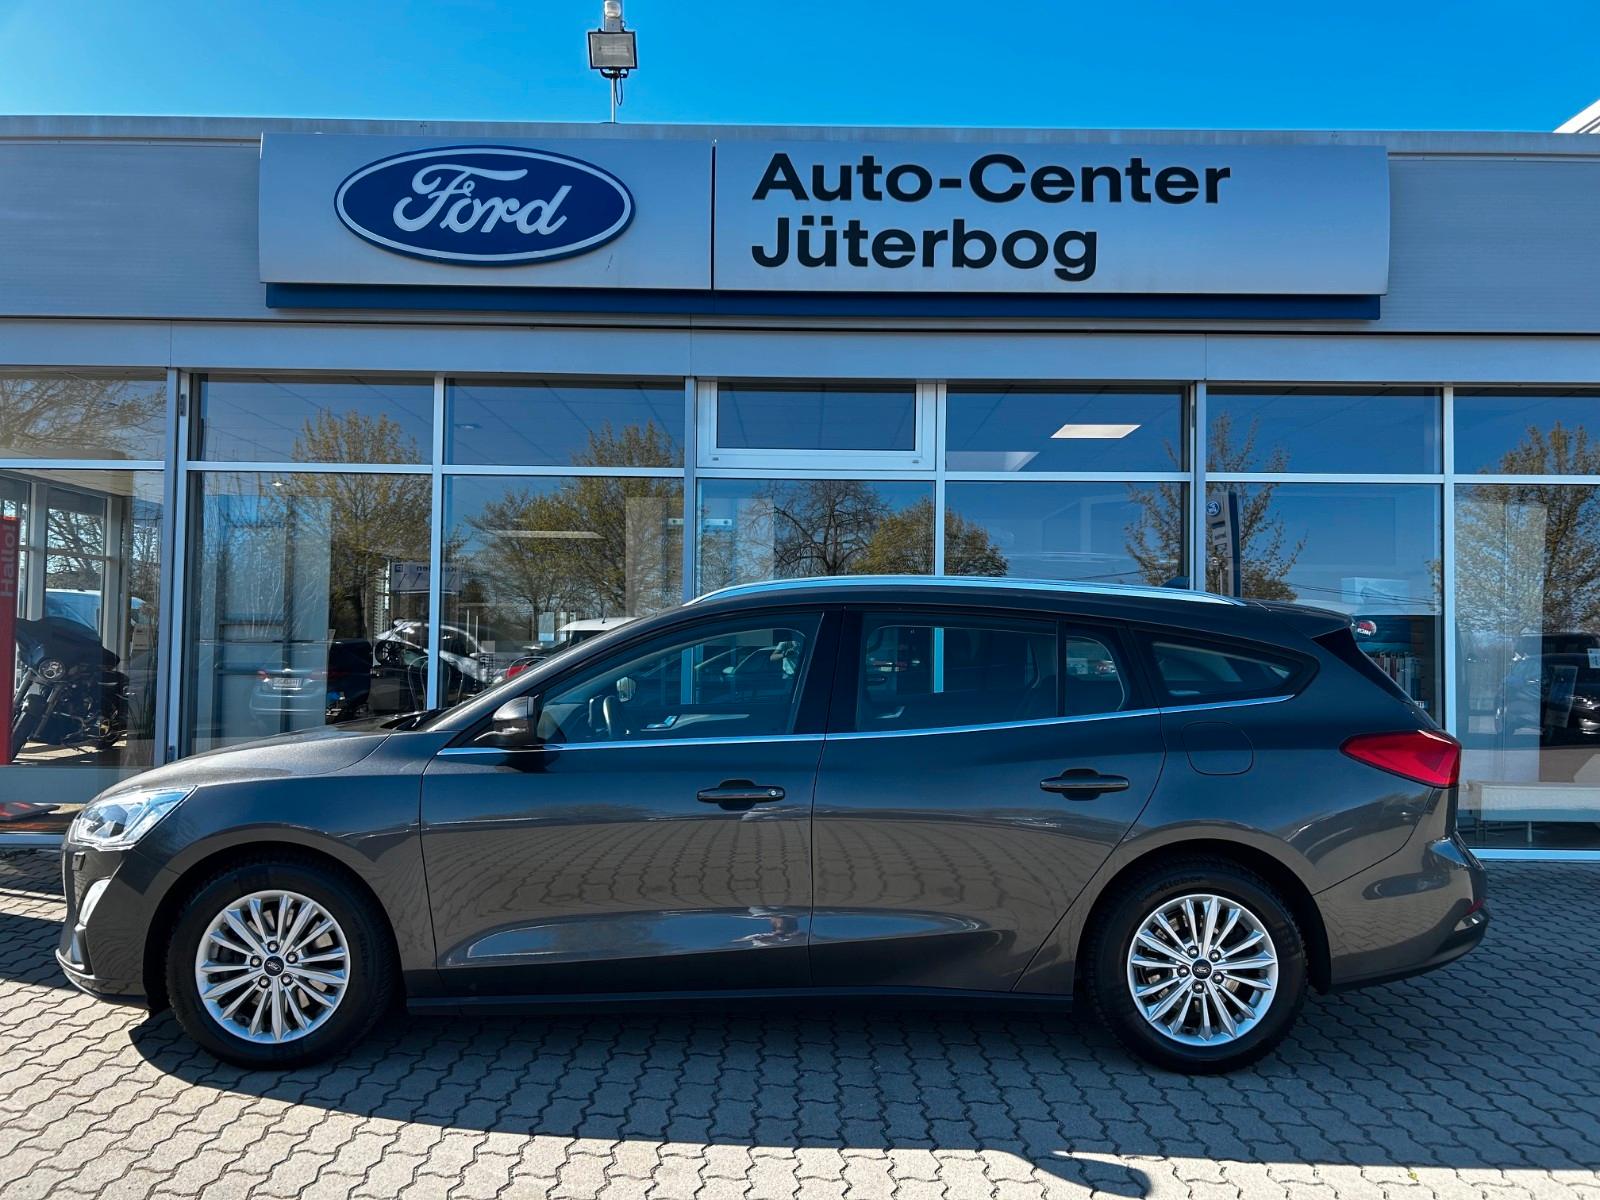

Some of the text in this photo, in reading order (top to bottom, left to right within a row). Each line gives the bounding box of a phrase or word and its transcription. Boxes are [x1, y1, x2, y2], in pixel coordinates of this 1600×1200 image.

[393, 164, 572, 235] Ford
[752, 153, 1231, 205] Auto-Center
[752, 215, 1097, 281] Jüterbog
